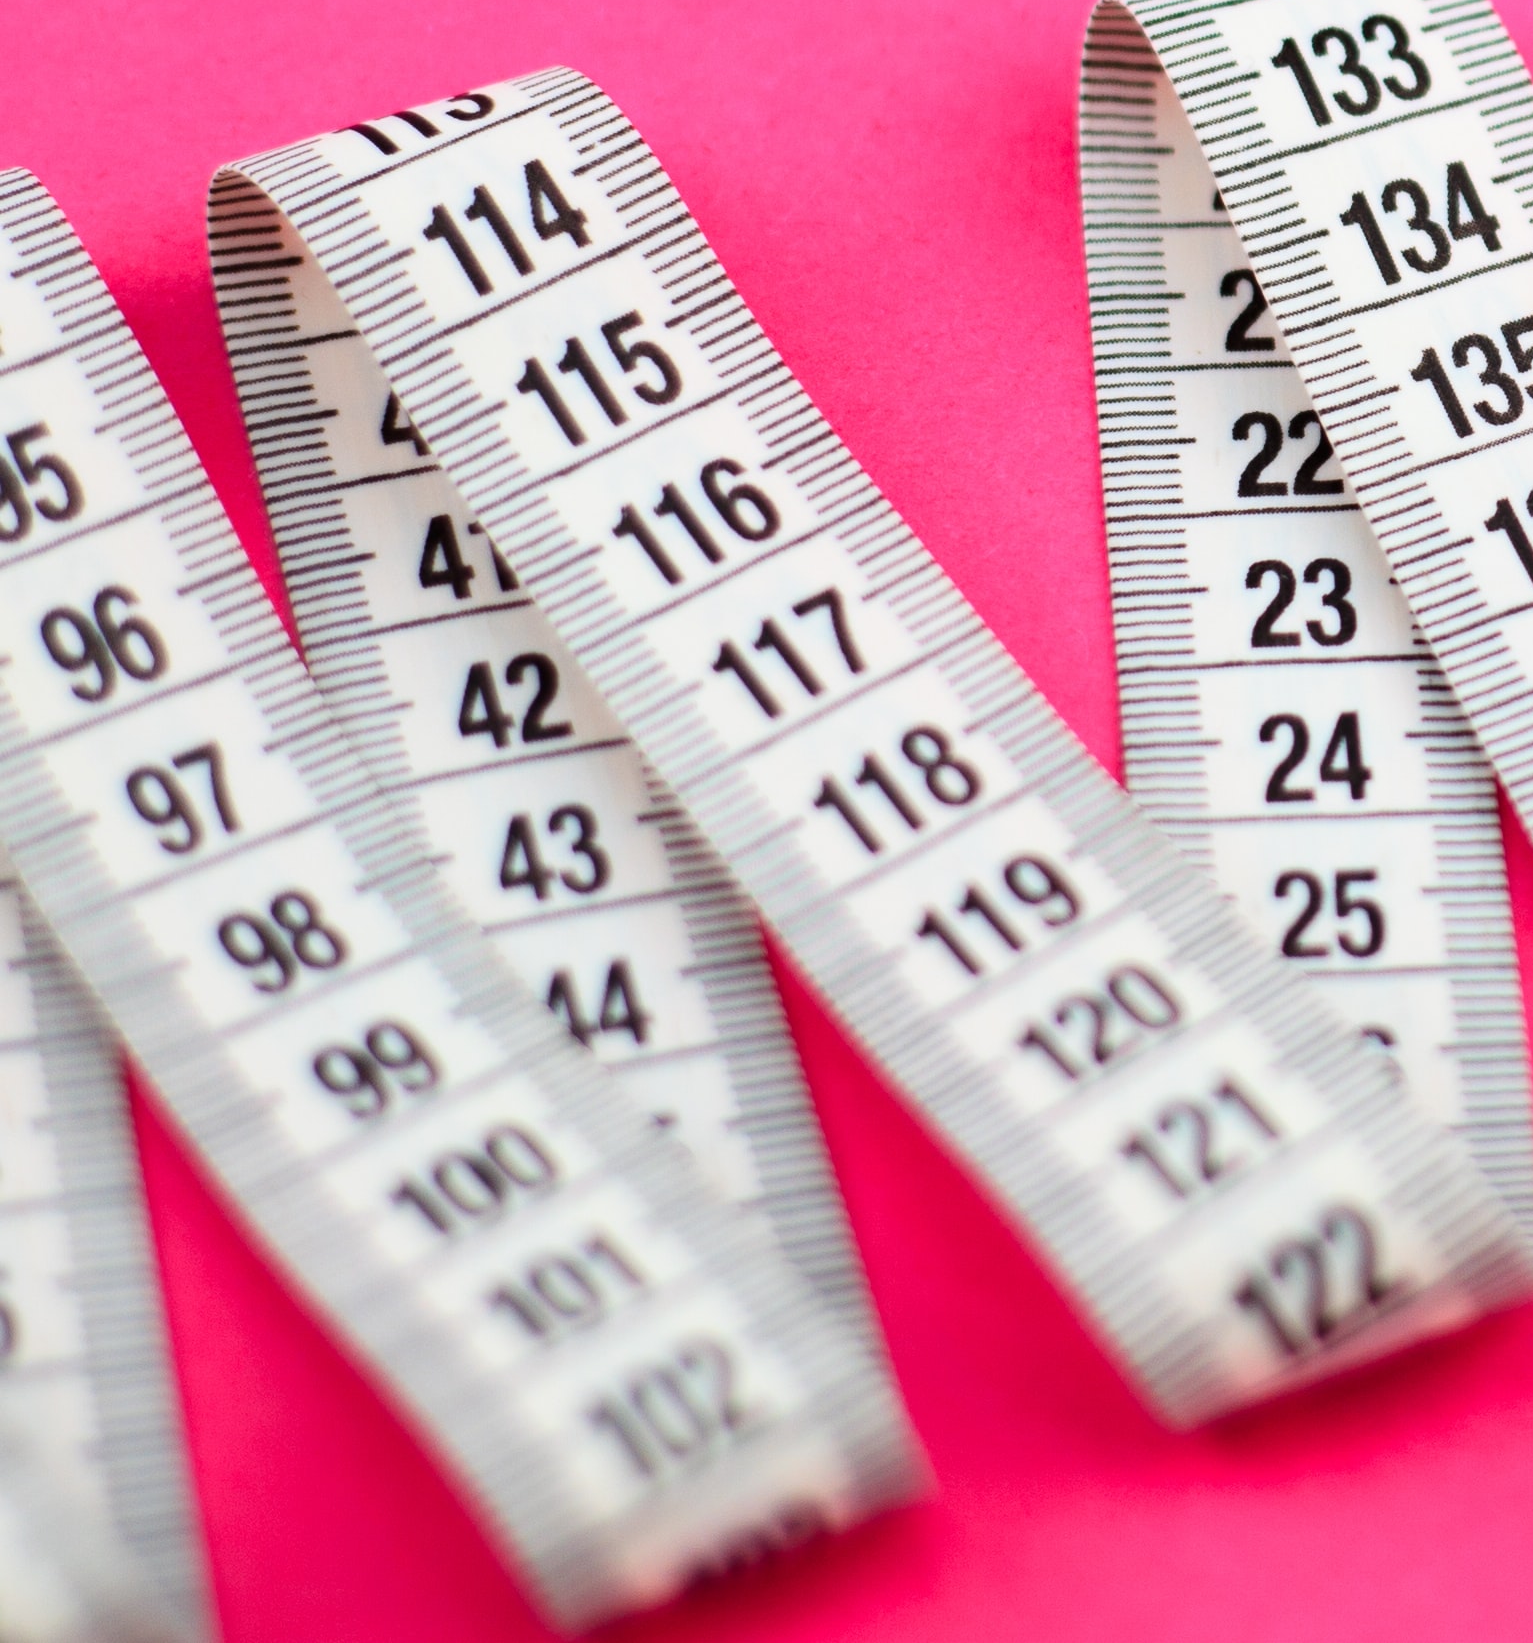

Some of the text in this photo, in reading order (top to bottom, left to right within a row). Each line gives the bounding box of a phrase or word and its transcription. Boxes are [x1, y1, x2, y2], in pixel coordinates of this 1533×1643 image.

[1272, 14, 1432, 127] 133
[423, 158, 591, 297] 114
[1340, 160, 1501, 285] 134
[1219, 268, 1276, 351] 2
[378, 391, 430, 457] 4
[517, 309, 683, 448] 115
[1232, 410, 1345, 498] 22
[612, 458, 783, 586] 116
[39, 584, 172, 704] 96
[712, 587, 865, 718] 117
[1245, 558, 1359, 648] 23
[457, 652, 575, 748] 42
[125, 744, 240, 856] 97
[814, 724, 983, 854] 118
[1258, 712, 1371, 802] 24
[498, 804, 612, 901] 43
[217, 889, 350, 995] 98
[915, 852, 1085, 975] 119
[1273, 868, 1385, 958] 25
[311, 1021, 443, 1118] 99
[1017, 965, 1183, 1081] 120
[390, 1123, 563, 1237] 100
[1120, 1075, 1282, 1198] 121
[485, 1228, 647, 1339] 101
[1232, 1205, 1391, 1357] 122
[583, 1335, 746, 1477] 102
